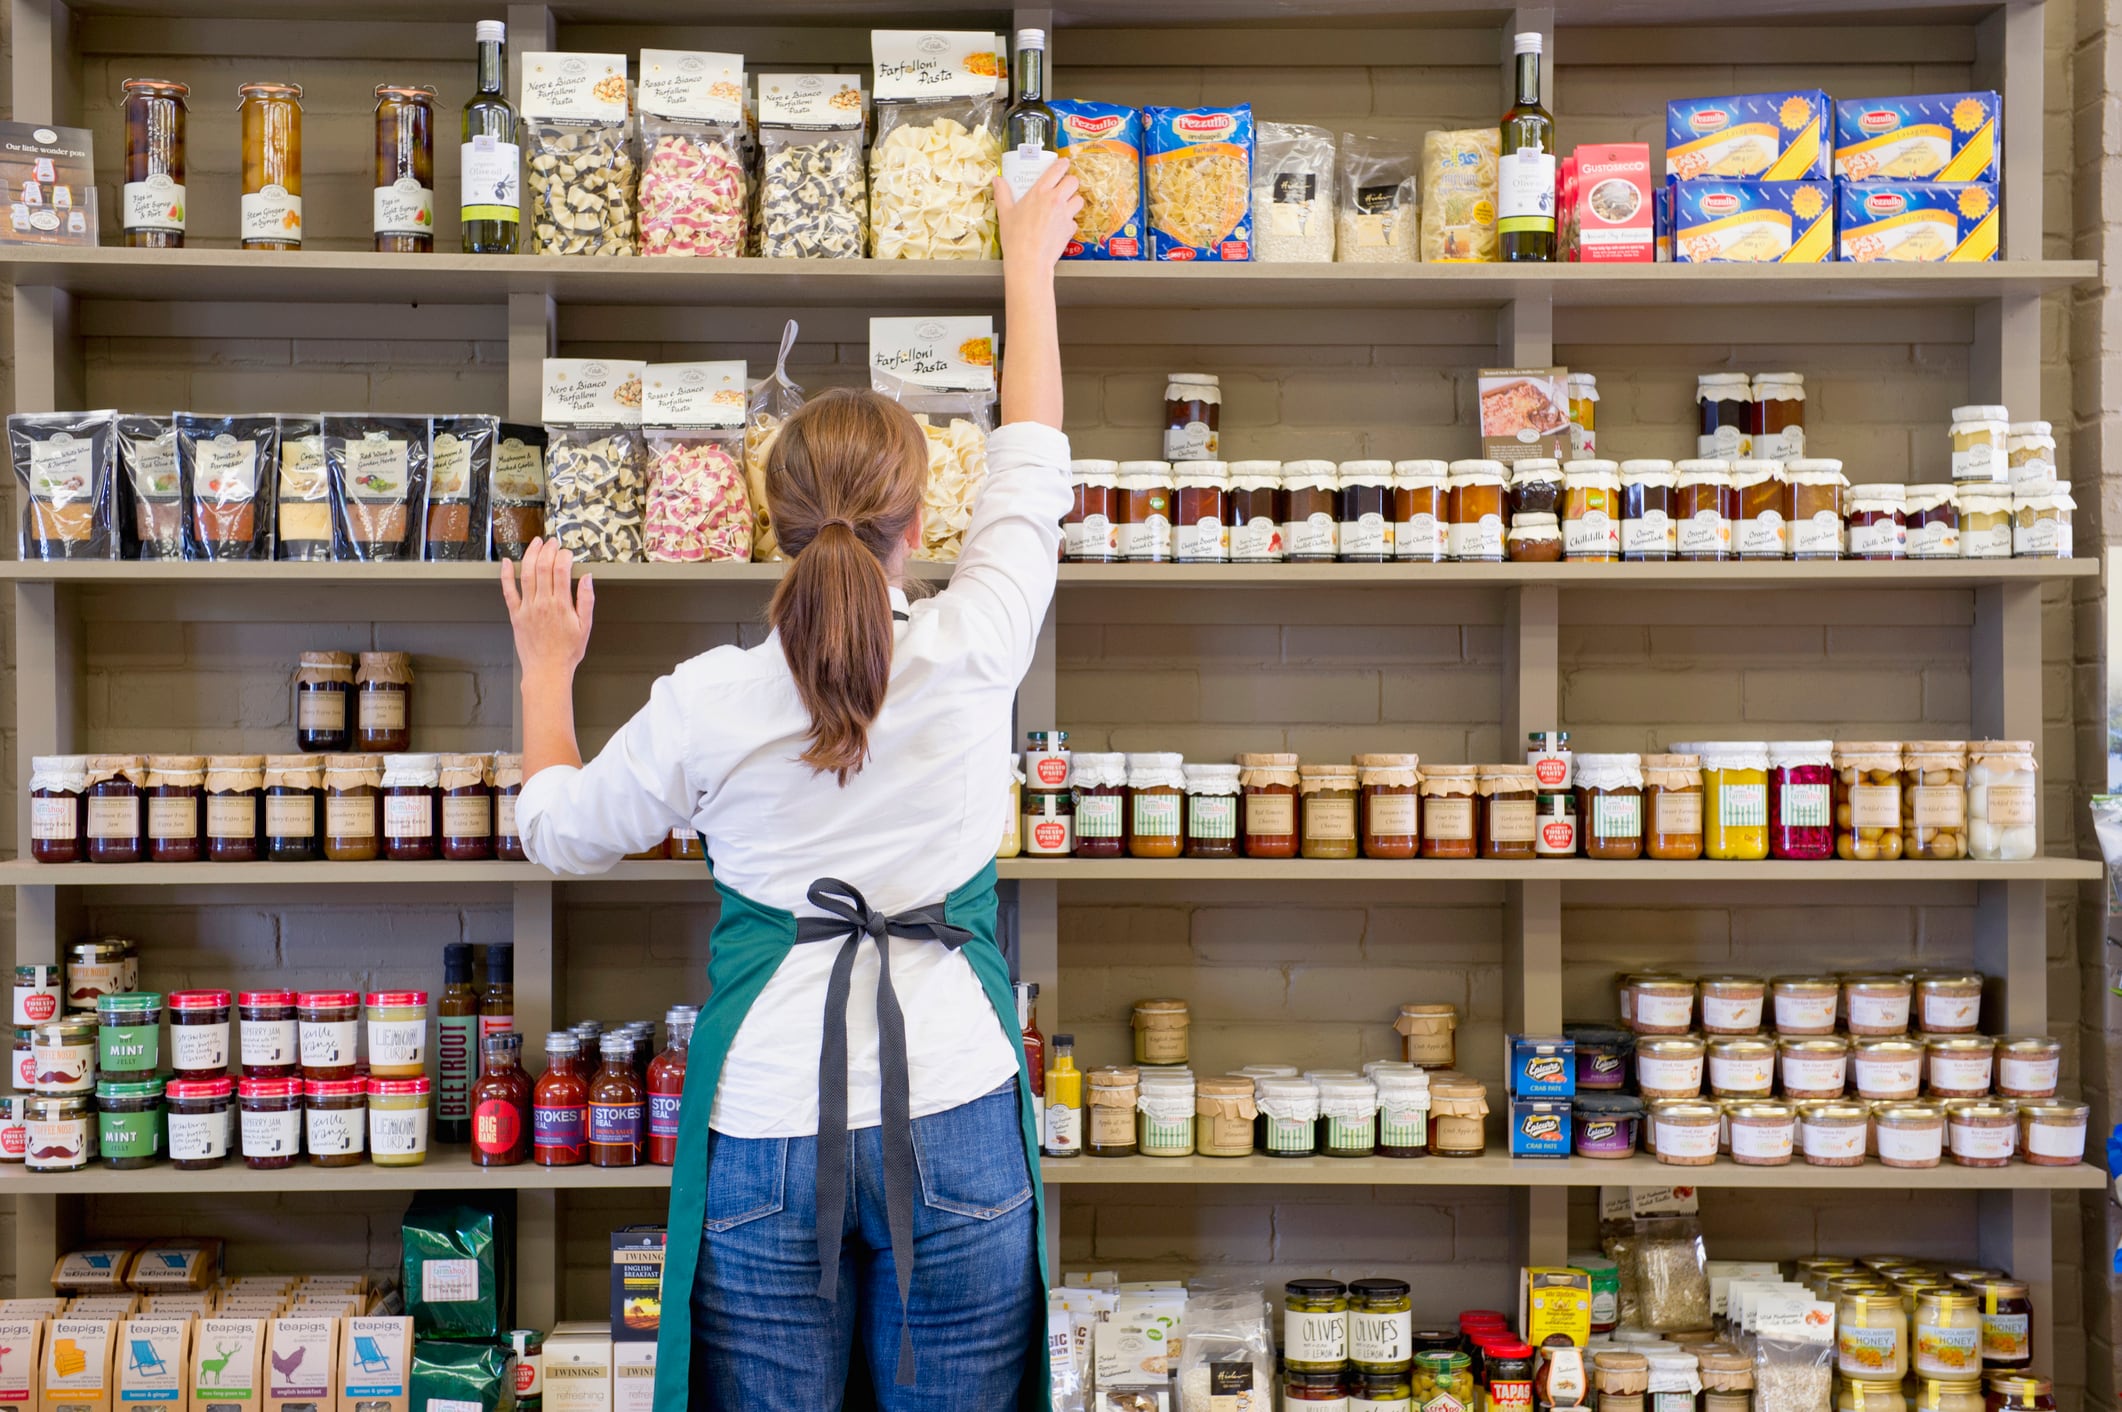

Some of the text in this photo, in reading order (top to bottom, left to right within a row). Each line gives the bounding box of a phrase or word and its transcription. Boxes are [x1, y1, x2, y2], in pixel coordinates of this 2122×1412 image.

[643, 79, 666, 89] Rosso
[674, 75, 703, 85] Bianco
[917, 70, 953, 86] Pasta
[527, 80, 546, 92] Nero
[555, 76, 586, 87] Bianco
[536, 88, 576, 100] Farfalloni
[654, 87, 690, 99] Farfalloni
[765, 94, 783, 103] Nero
[791, 89, 822, 99] Bianco
[547, 97, 573, 106] Pasta
[663, 95, 687, 105] Pasta
[774, 98, 812, 110] Farfalloni
[787, 106, 810, 115] Pasta
[1069, 114, 1119, 132] Pezzullo
[1179, 113, 1230, 129] Pezzullo
[1694, 113, 1726, 124] Pezzullo
[1862, 114, 1897, 125] Pezzullo
[22, 143, 38, 152] little
[40, 146, 68, 155] wonder
[469, 168, 489, 176] Olive
[1582, 161, 1645, 174] GUSTOSECCO
[1513, 179, 1534, 187] Olive
[151, 201, 171, 210] Syrup
[1705, 197, 1738, 208] Pezzullo
[1869, 197, 1903, 208] Pezzullo
[246, 207, 286, 221] Stem Ginger
[398, 205, 418, 215] Syrup
[259, 217, 280, 229] Syrup
[394, 215, 409, 223] Port
[912, 360, 948, 374] Pasta
[548, 386, 567, 396] Nero
[576, 380, 607, 391] Bianco
[647, 392, 669, 401] Rosso
[677, 386, 705, 396] Bianco
[558, 392, 597, 403] Farfalloni
[658, 397, 693, 408] Farfalloni
[568, 401, 595, 411] Pasta
[213, 452, 234, 461] Tomato
[373, 450, 387, 459] Wine
[498, 456, 524, 464] Mushroom
[210, 460, 244, 470] Parmesan
[516, 461, 534, 471] Garlic
[1687, 529, 1708, 539] Orange
[1749, 530, 1770, 540] Orange
[376, 1028, 418, 1046] LEMON
[110, 1045, 144, 1056] MINT
[385, 1047, 405, 1060] CURD
[440, 1023, 467, 1116] BEETROOT
[1530, 1060, 1560, 1079] Epicure
[652, 1098, 681, 1112] STOK
[535, 1110, 577, 1122] STOKES
[595, 1108, 641, 1120] STOKES
[652, 1110, 669, 1119] REAL
[375, 1116, 415, 1135] LEMON
[595, 1119, 613, 1127] REAL
[1526, 1118, 1557, 1136] Epicure
[105, 1131, 137, 1142] MINT
[478, 1132, 497, 1144] BANG
[1587, 1125, 1612, 1140] Epicure
[625, 1252, 663, 1261] TWINING
[57, 1323, 105, 1334] teapigs.
[130, 1324, 179, 1334] teapigs.
[206, 1322, 254, 1333] teapigs.
[279, 1322, 328, 1332] teapigs.
[353, 1321, 402, 1331] teapigs.
[1303, 1318, 1344, 1342] OLIVES
[1355, 1318, 1398, 1344] OLIVES
[1990, 1323, 2023, 1333] HONEY
[1855, 1335, 1890, 1345] HONEY
[1939, 1335, 1972, 1345] HONEY
[1313, 1350, 1332, 1358] LEMON
[1363, 1350, 1384, 1359] LEMON
[554, 1368, 600, 1377] TWININGS
[153, 1391, 170, 1399] ginger
[556, 1391, 604, 1402] refreshing
[1493, 1383, 1530, 1399] TAPAS
